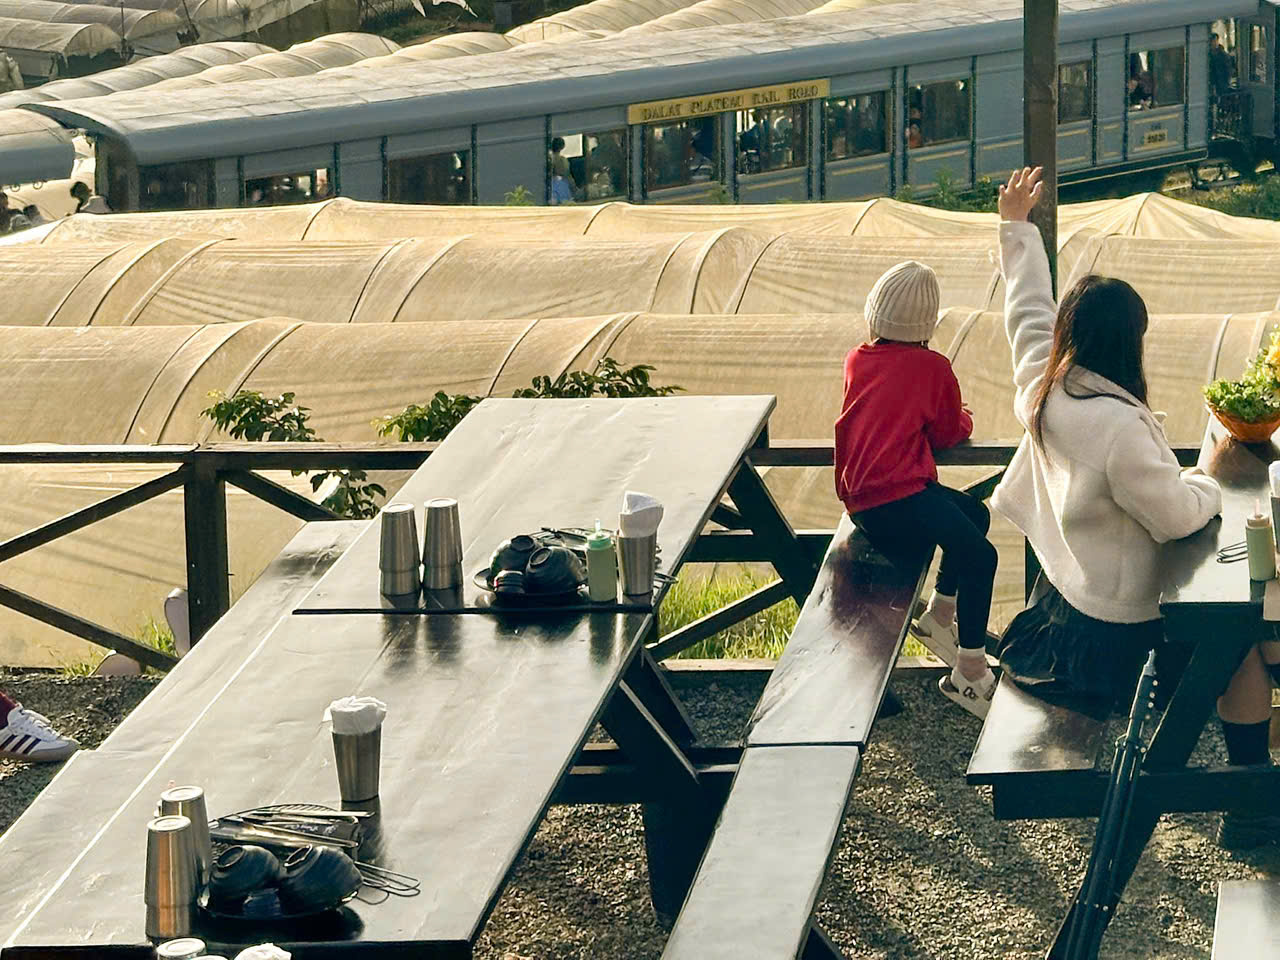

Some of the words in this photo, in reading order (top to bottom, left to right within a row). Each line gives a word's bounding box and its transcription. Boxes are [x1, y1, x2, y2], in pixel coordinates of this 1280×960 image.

[643, 103, 681, 121] DALAT
[691, 95, 743, 114] PLATEAU
[751, 90, 781, 105] RAIL
[788, 85, 819, 100] ROAD
